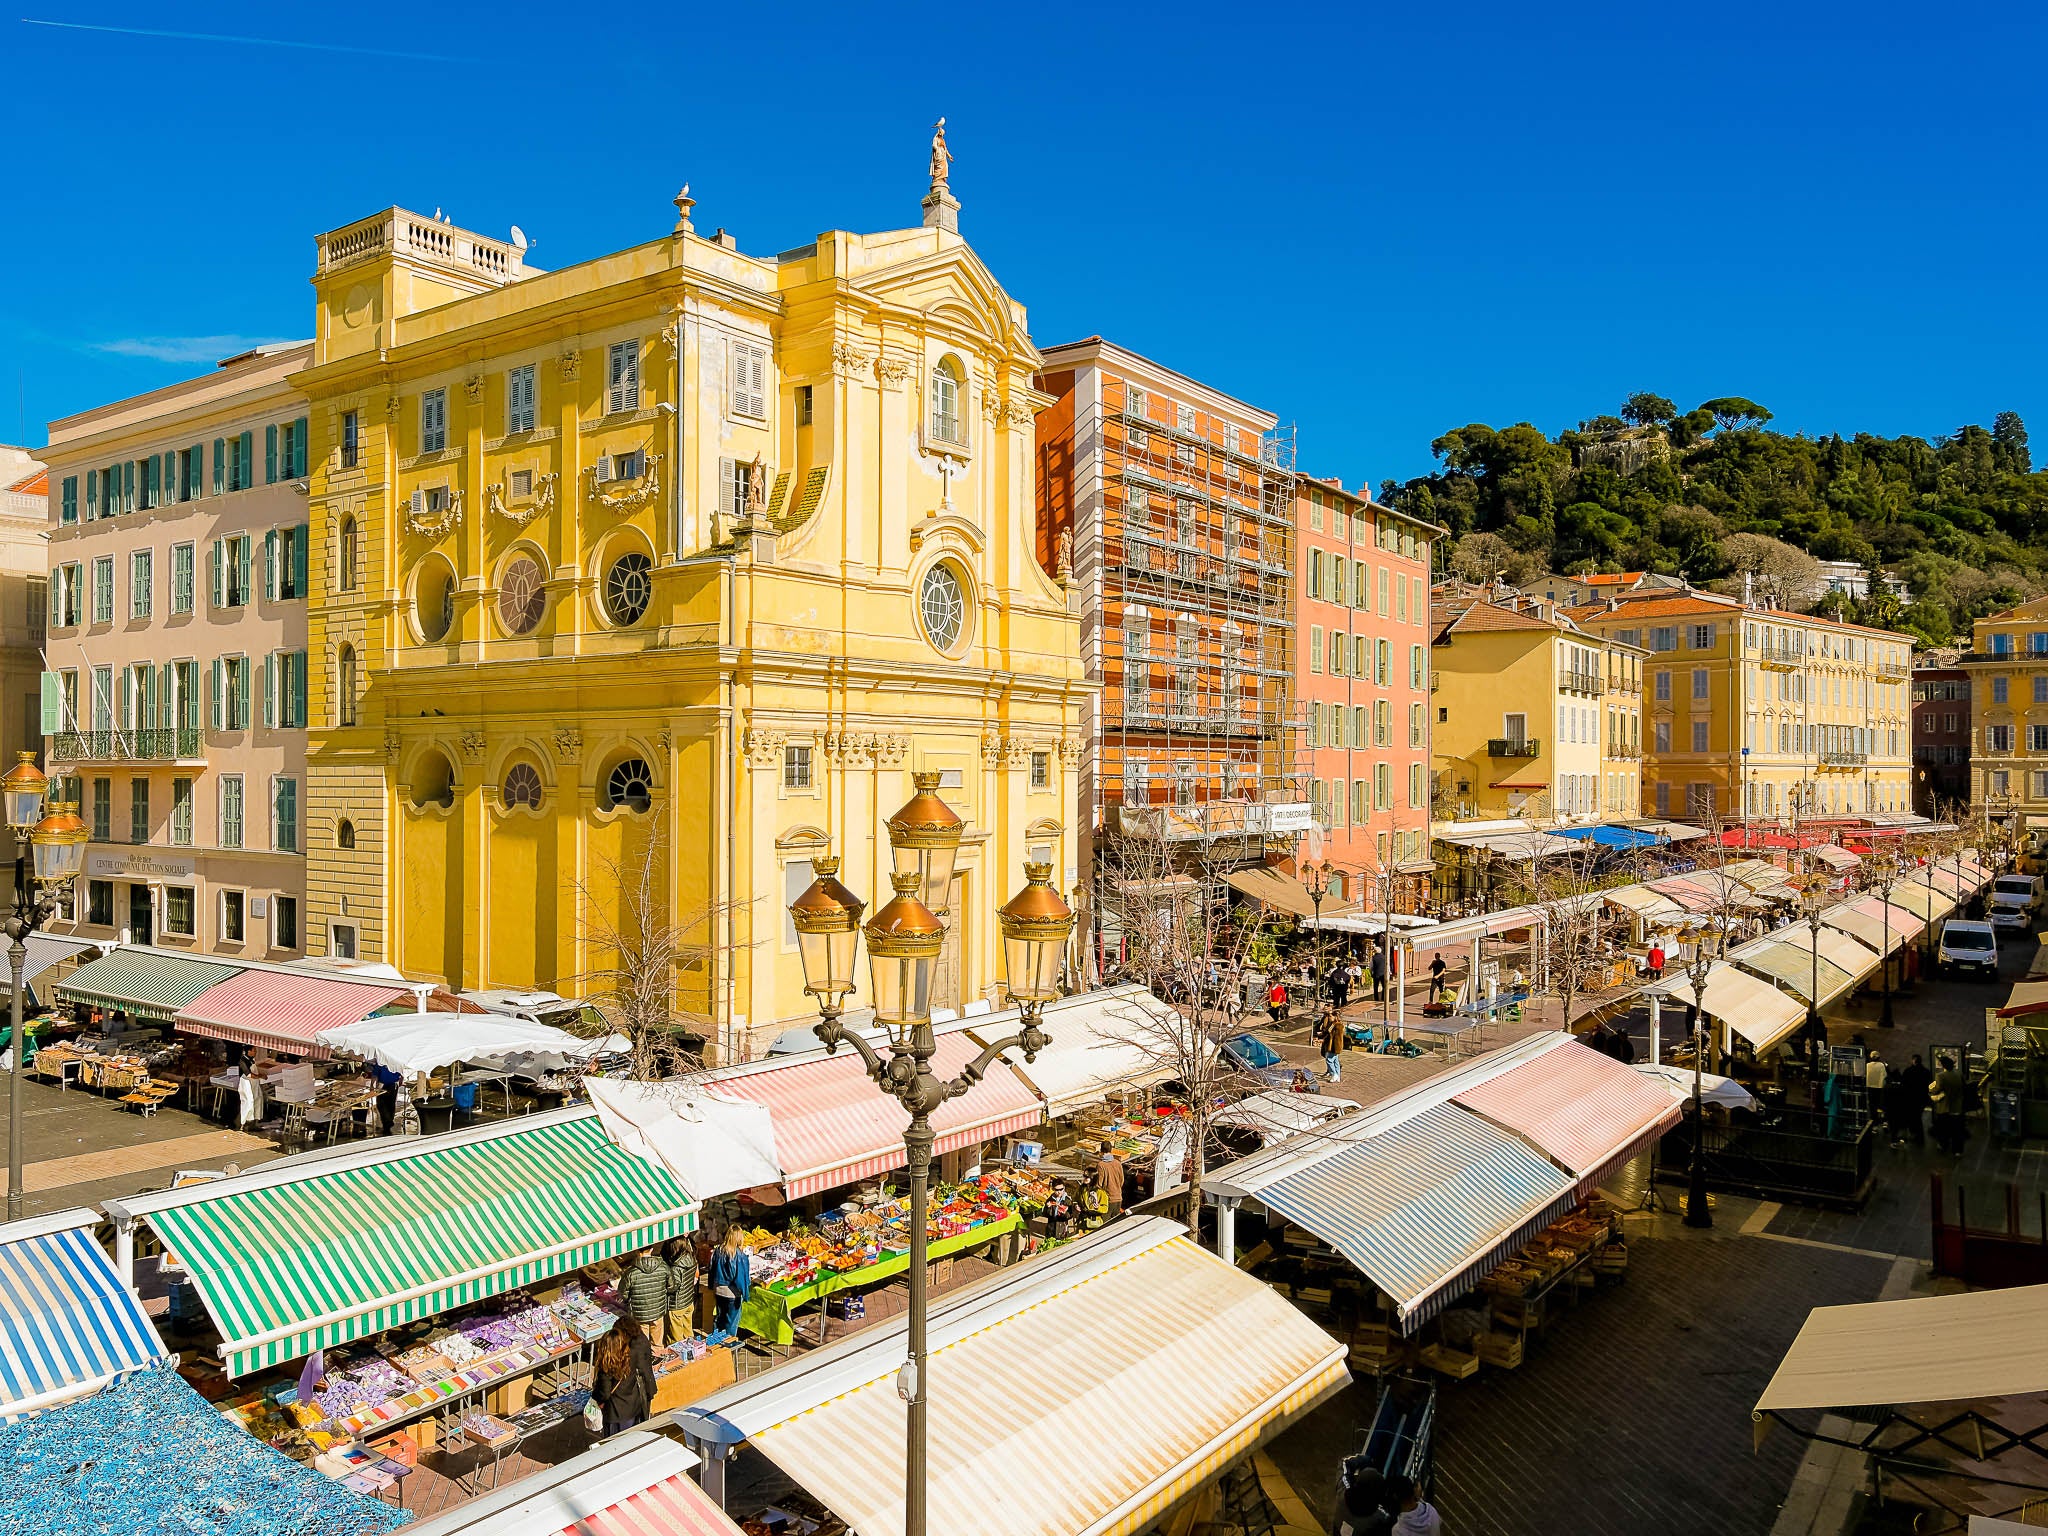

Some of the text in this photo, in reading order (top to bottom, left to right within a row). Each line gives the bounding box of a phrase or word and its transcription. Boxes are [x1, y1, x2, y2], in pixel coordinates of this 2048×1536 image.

[96, 859, 113, 868] CENTRE
[114, 861, 140, 871] COMMUNAL
[164, 864, 187, 874] SOCIALE
